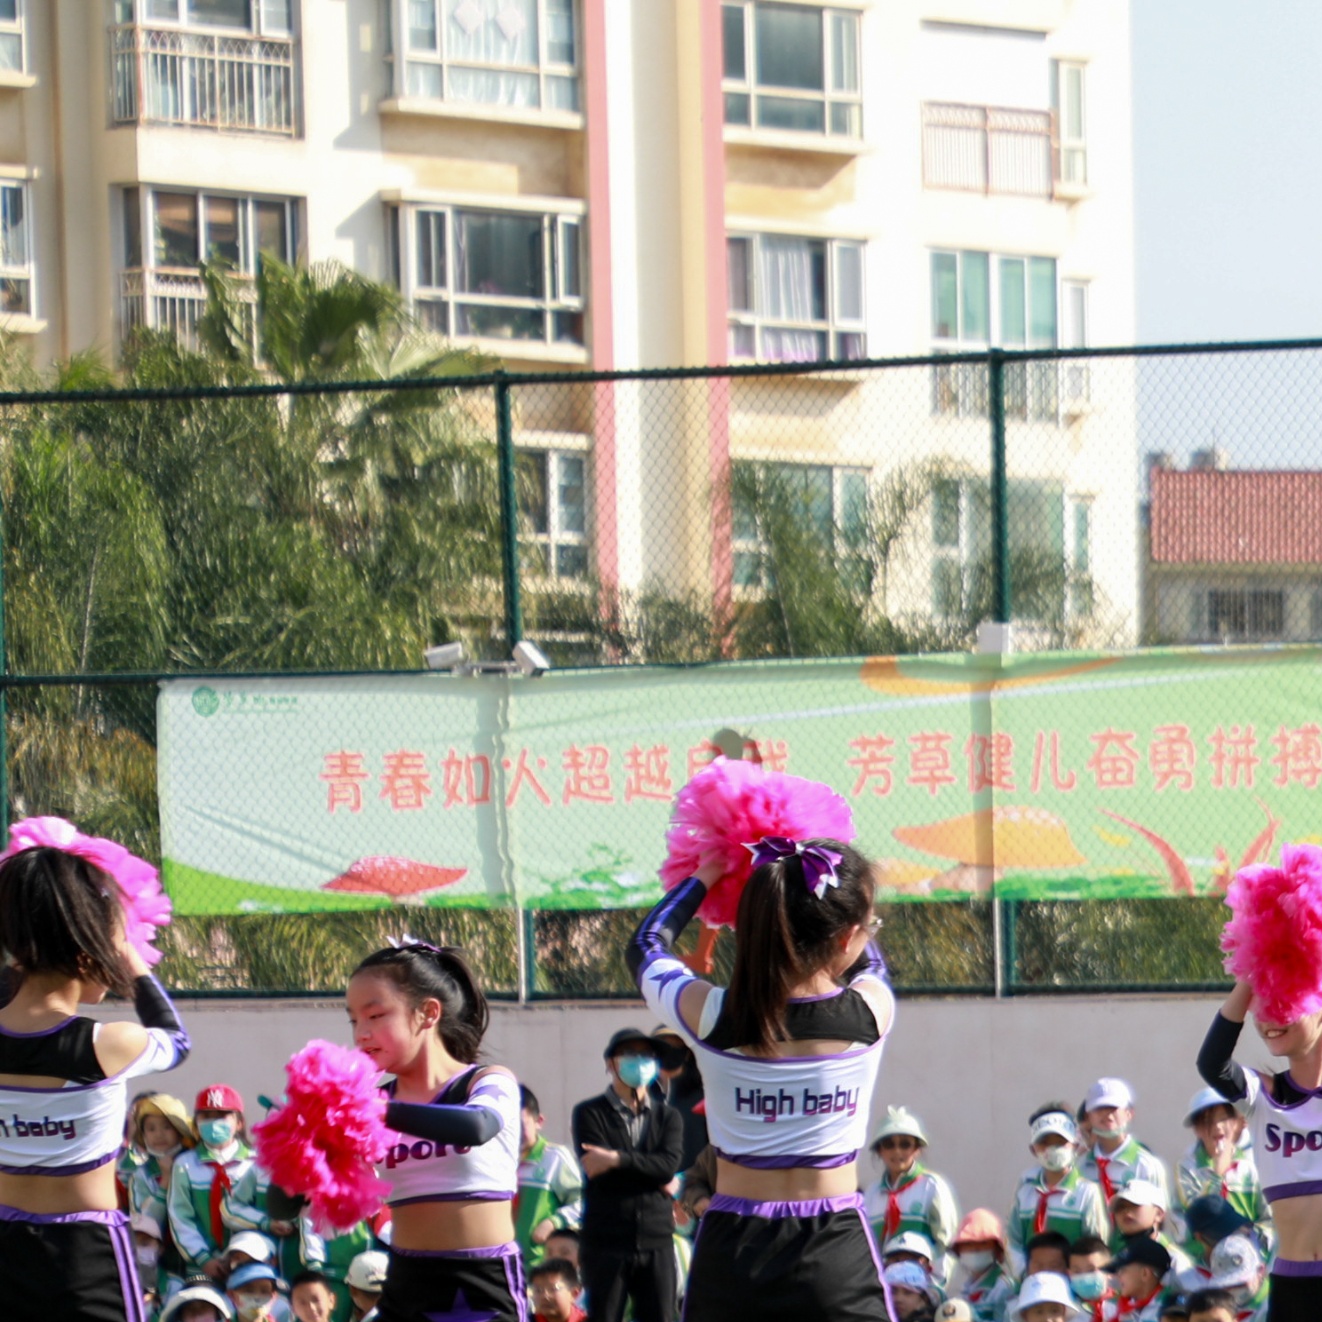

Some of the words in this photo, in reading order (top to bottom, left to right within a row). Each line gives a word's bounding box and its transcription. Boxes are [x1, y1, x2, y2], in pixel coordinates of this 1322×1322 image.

[734, 1087, 795, 1122] High
[802, 1084, 860, 1117] baby
[12, 1113, 77, 1141] baby
[374, 1140, 472, 1169] por
